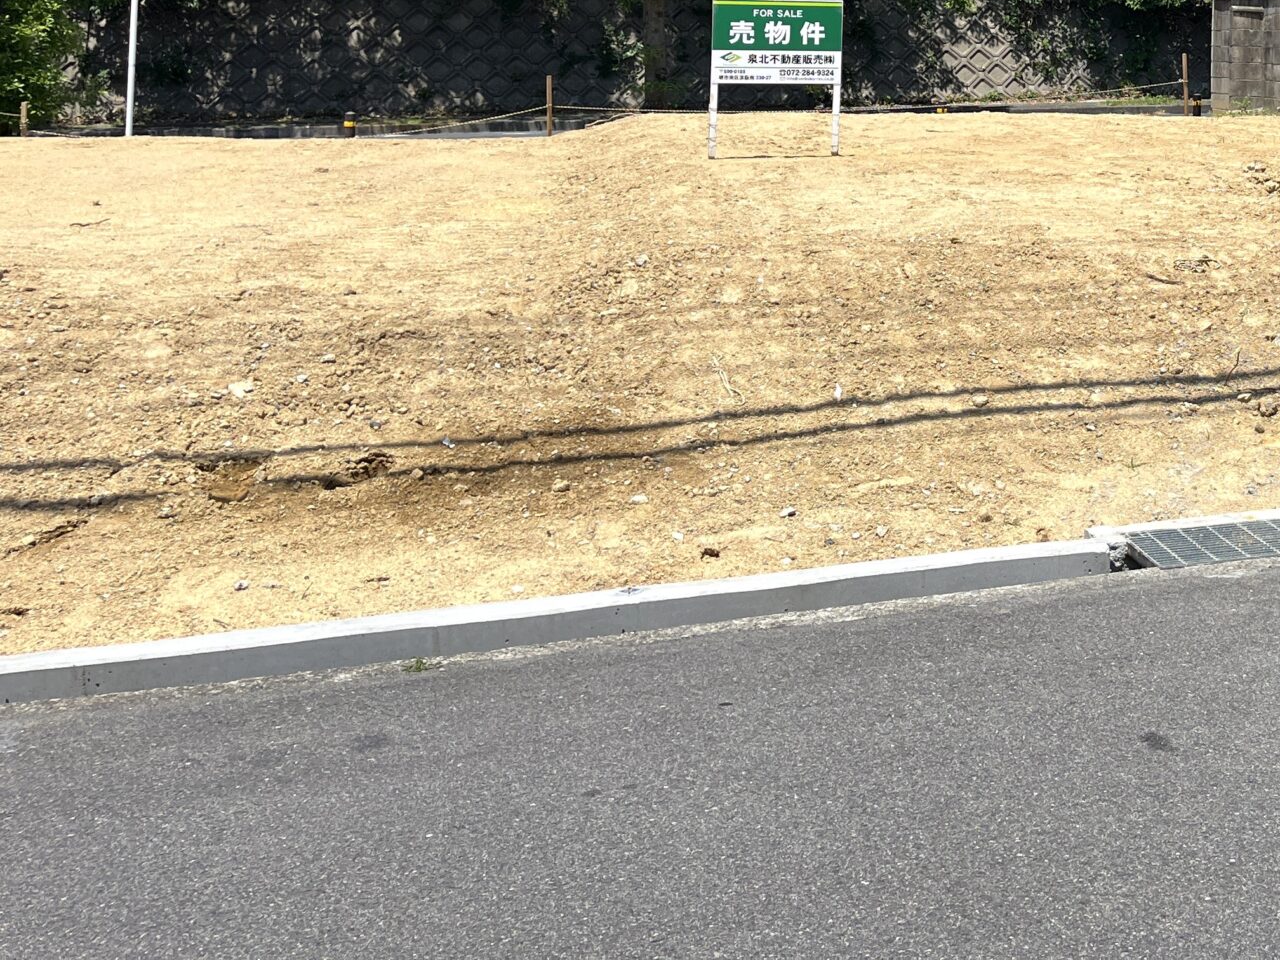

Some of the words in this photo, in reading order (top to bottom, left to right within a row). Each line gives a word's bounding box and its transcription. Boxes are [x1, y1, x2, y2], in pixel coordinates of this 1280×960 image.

[753, 9, 774, 17] FOR
[777, 9, 803, 18] SALE
[729, 20, 825, 45] 売物件
